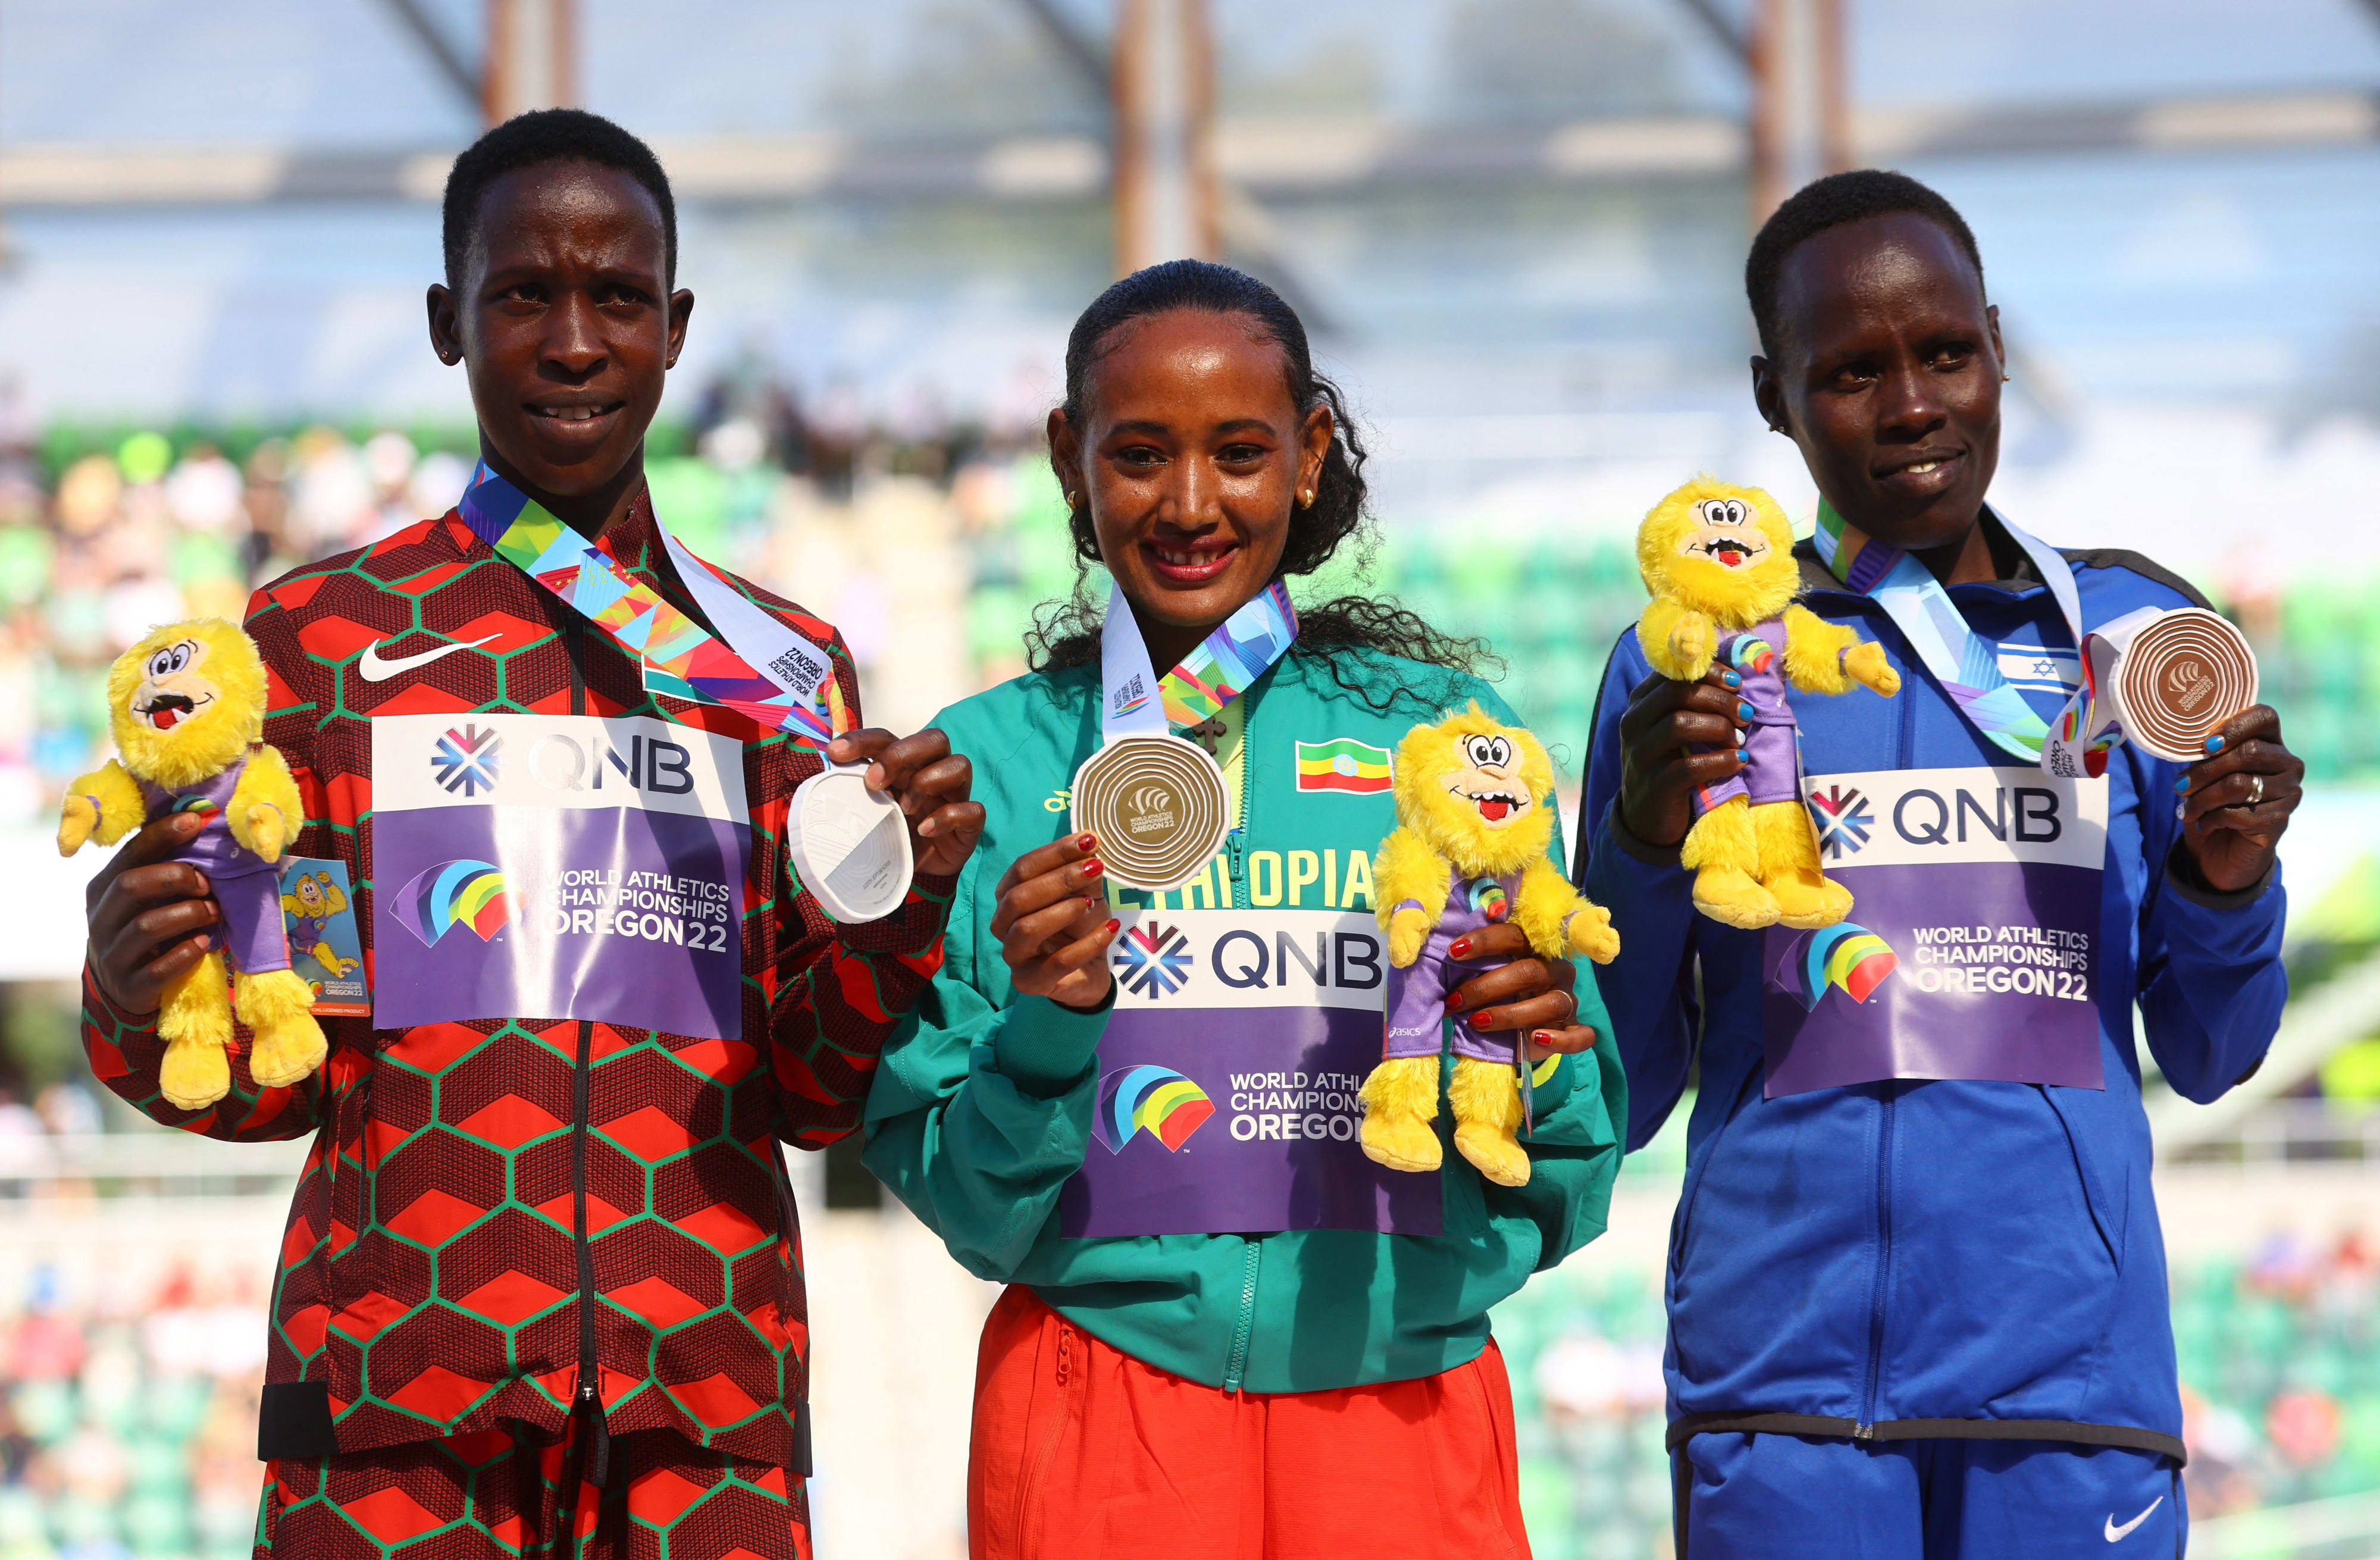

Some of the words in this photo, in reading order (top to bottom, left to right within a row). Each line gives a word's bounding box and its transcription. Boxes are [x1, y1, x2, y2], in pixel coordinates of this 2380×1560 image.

[768, 660, 793, 683] ATHLETICS
[776, 656, 816, 689] CHAMPIONSHIPS
[785, 647, 823, 679] OREGON22
[791, 681, 810, 697] WORLD
[528, 734, 694, 794] QNB
[1893, 787, 2062, 845] QNB
[627, 870, 729, 902] ATHLETICS
[543, 888, 728, 923] CHAMPIONSHIPS
[1913, 926, 1992, 944] WORLD
[1996, 926, 2089, 951] ATHLETICS
[1211, 929, 1383, 989] QNB
[1915, 945, 2088, 972] CHAMPIONSHIPS
[1916, 966, 2088, 1002] OREGON22
[1230, 1072, 1308, 1090] WORLD
[1314, 1072, 1362, 1092] ATHL
[1230, 1091, 1367, 1114] CHAMPION
[1230, 1113, 1365, 1143] OREGO
